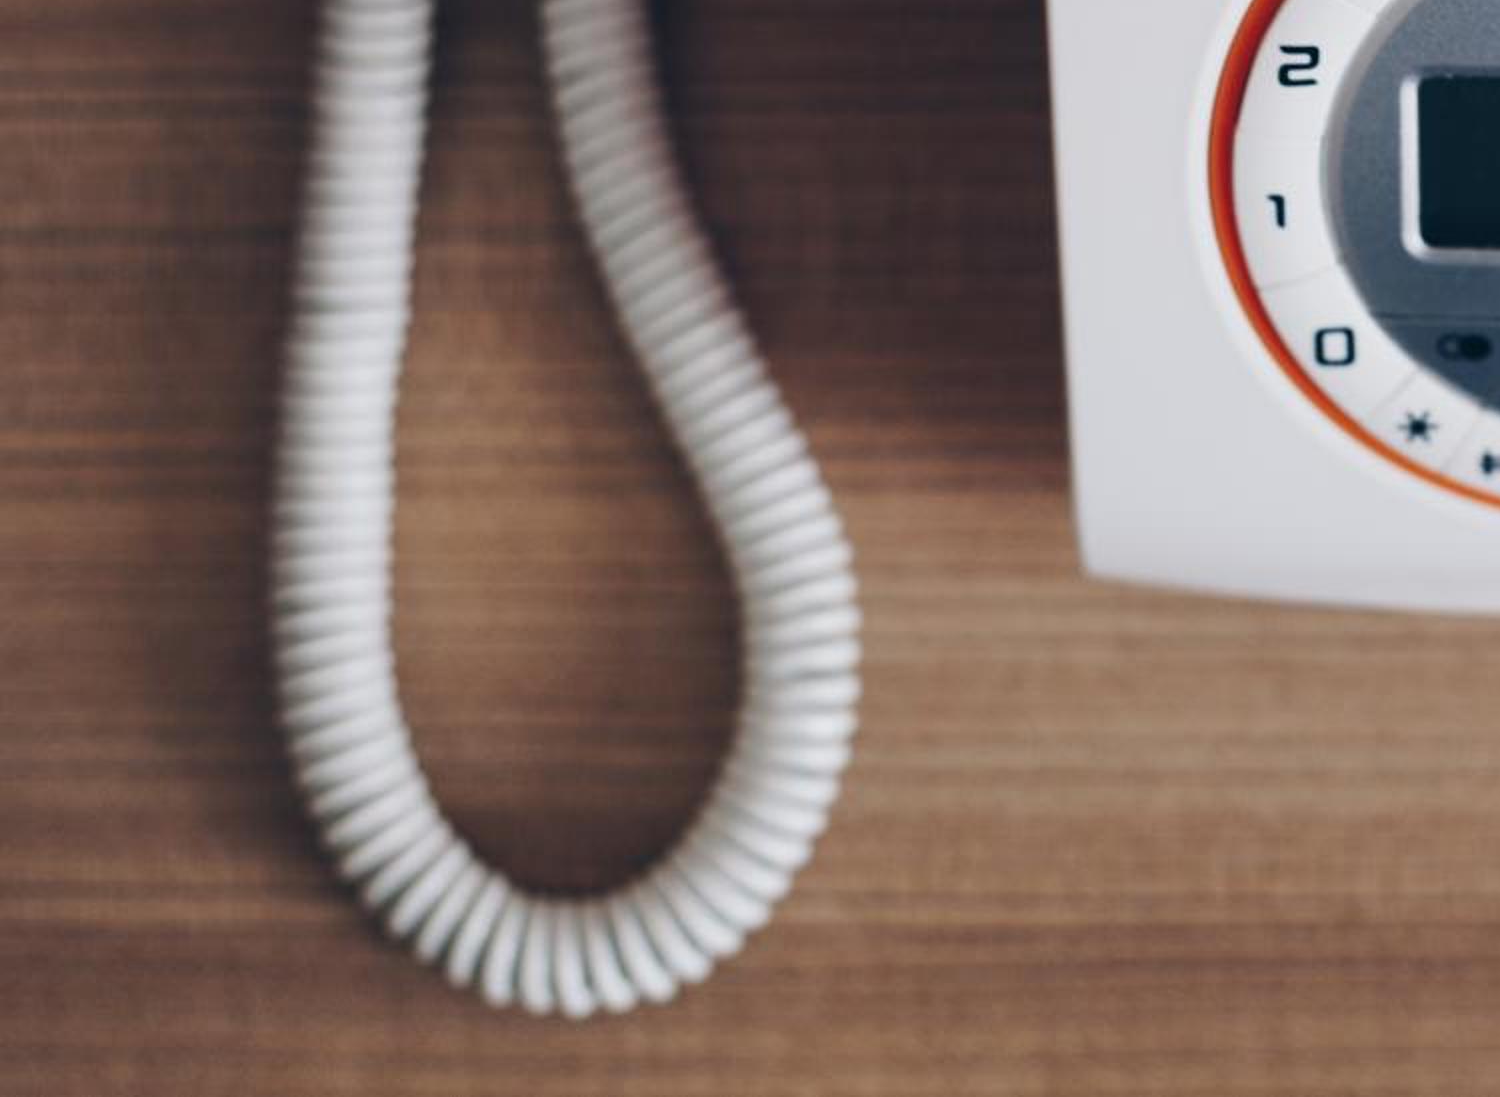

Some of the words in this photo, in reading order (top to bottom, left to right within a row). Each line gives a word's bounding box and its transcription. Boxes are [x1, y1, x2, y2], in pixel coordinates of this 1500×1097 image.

[1278, 45, 1320, 87] 2
[1267, 194, 1286, 229] 1
[1314, 327, 1356, 367] 0
